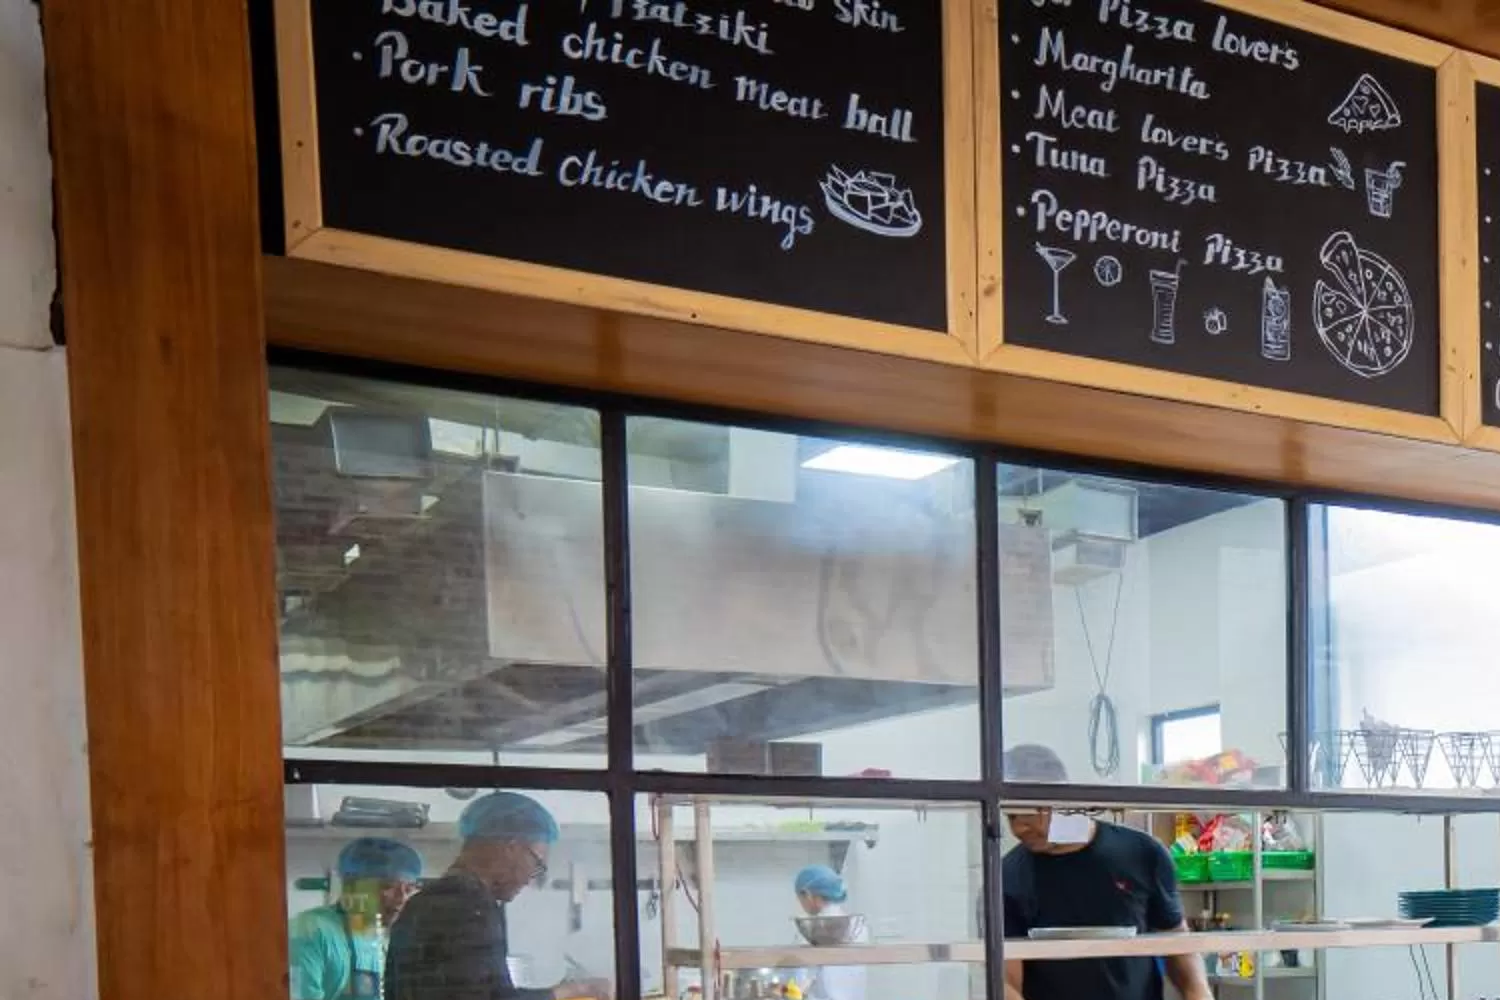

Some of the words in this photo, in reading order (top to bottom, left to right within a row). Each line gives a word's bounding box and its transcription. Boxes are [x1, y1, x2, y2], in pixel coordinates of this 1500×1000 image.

[374, 31, 492, 97] Pork
[519, 76, 608, 121] ribs
[562, 21, 716, 90] chicken
[734, 75, 829, 119] meat
[843, 93, 918, 143] ball
[370, 113, 543, 177] Roasted
[715, 184, 814, 250] wings
[1025, 131, 1110, 178] Tuna
[1136, 156, 1218, 204] Pizza
[1033, 84, 1121, 132] Meat
[1247, 144, 1333, 187] Pizza
[1031, 189, 1182, 253] Pepperoni
[1203, 233, 1285, 274] Pizza
